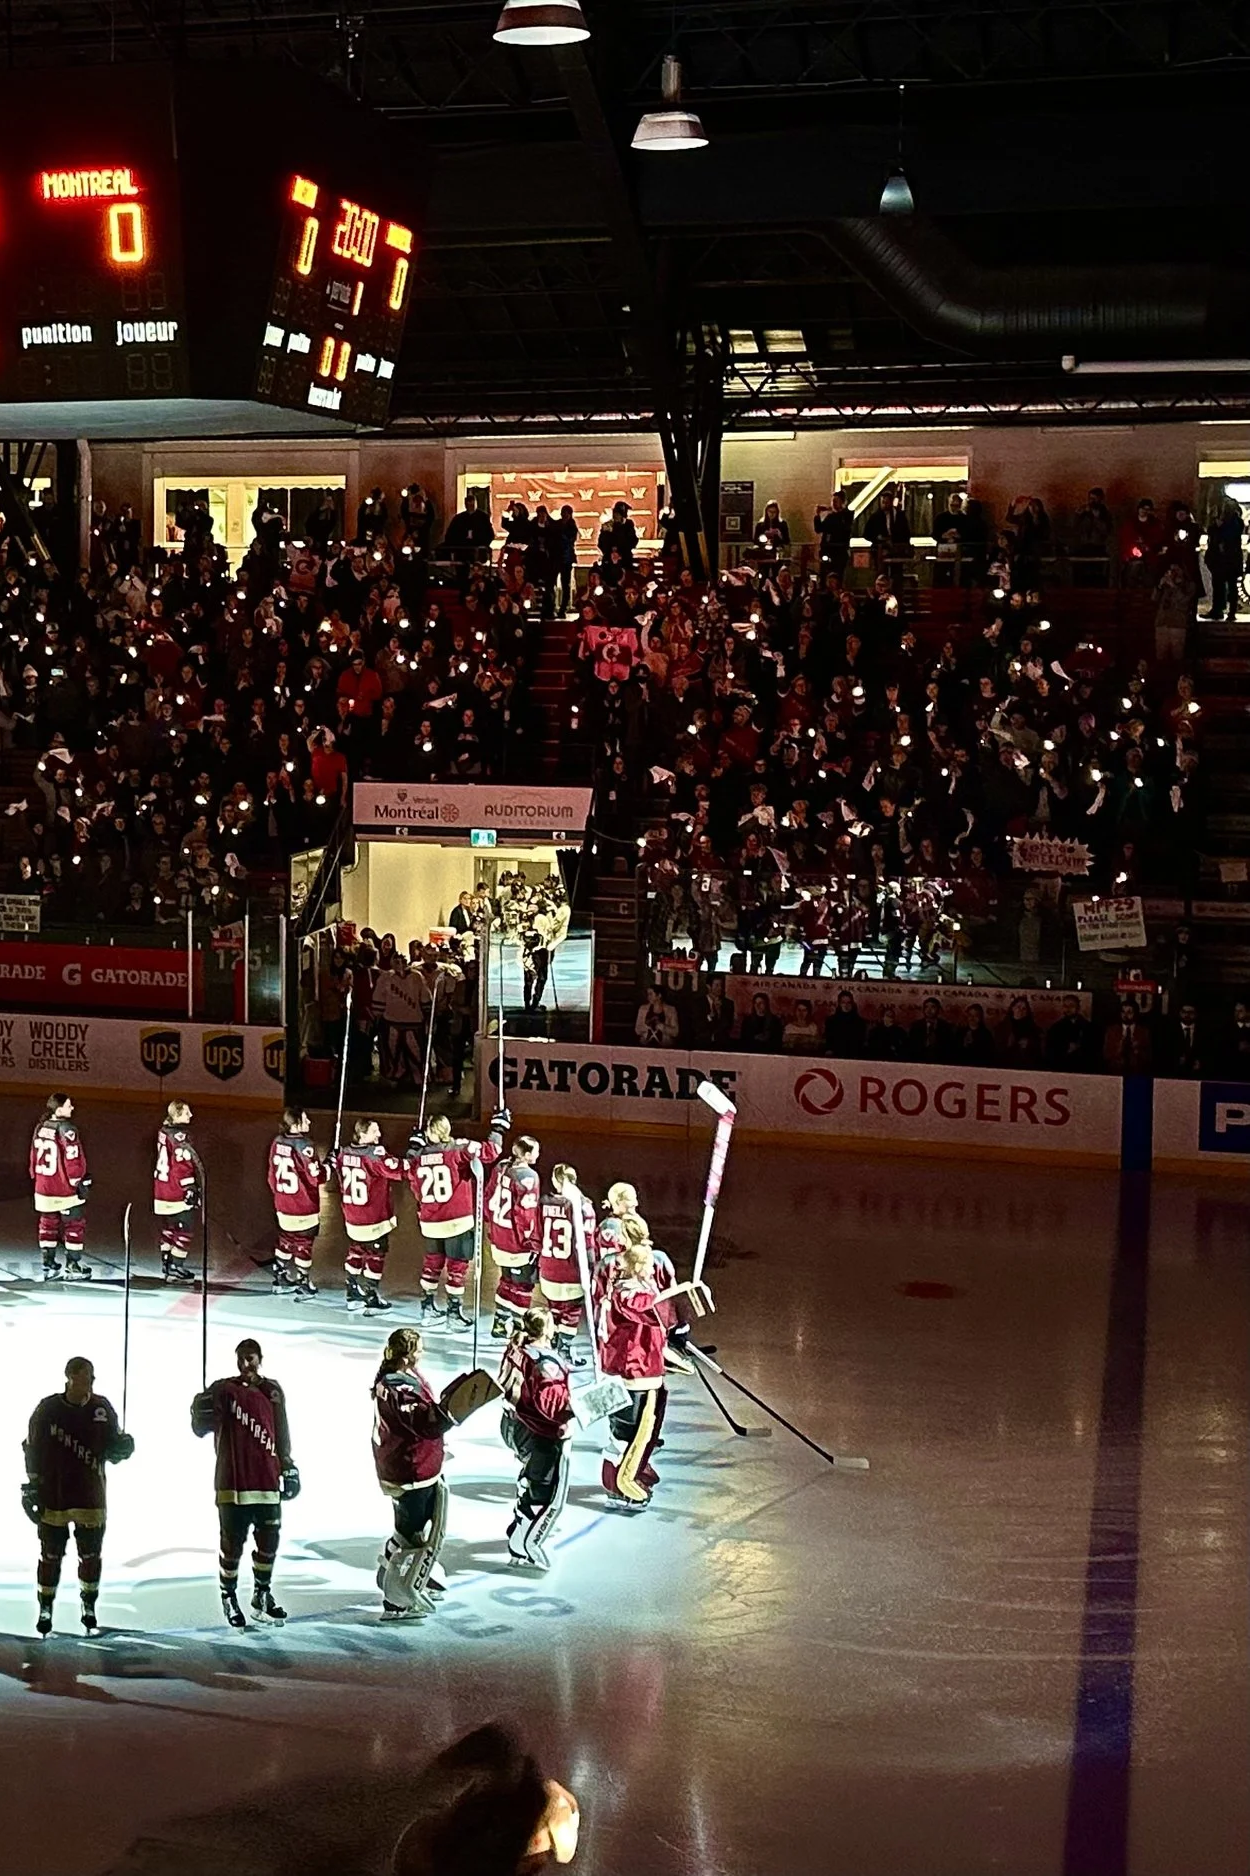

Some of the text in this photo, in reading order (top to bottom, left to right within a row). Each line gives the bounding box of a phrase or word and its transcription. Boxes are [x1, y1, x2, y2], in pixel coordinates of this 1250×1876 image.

[42, 168, 138, 199] MONTREAL
[109, 203, 144, 263] 0
[22, 323, 93, 349] punition
[116, 320, 178, 346] joueur
[374, 804, 439, 820] Montréal
[485, 804, 573, 818] AUDITORIUM
[90, 970, 188, 988] GATORADE
[29, 1021, 89, 1041] WOODY
[28, 1058, 91, 1072] DISTILLERS
[31, 1040, 87, 1060] CREEK
[142, 1040, 179, 1070] ups
[205, 1044, 243, 1074] ups
[859, 1074, 1071, 1127] ROGERS
[341, 1166, 369, 1206] 26
[416, 1164, 454, 1204] 28
[488, 1187, 514, 1230] 42
[541, 1217, 573, 1261] 13
